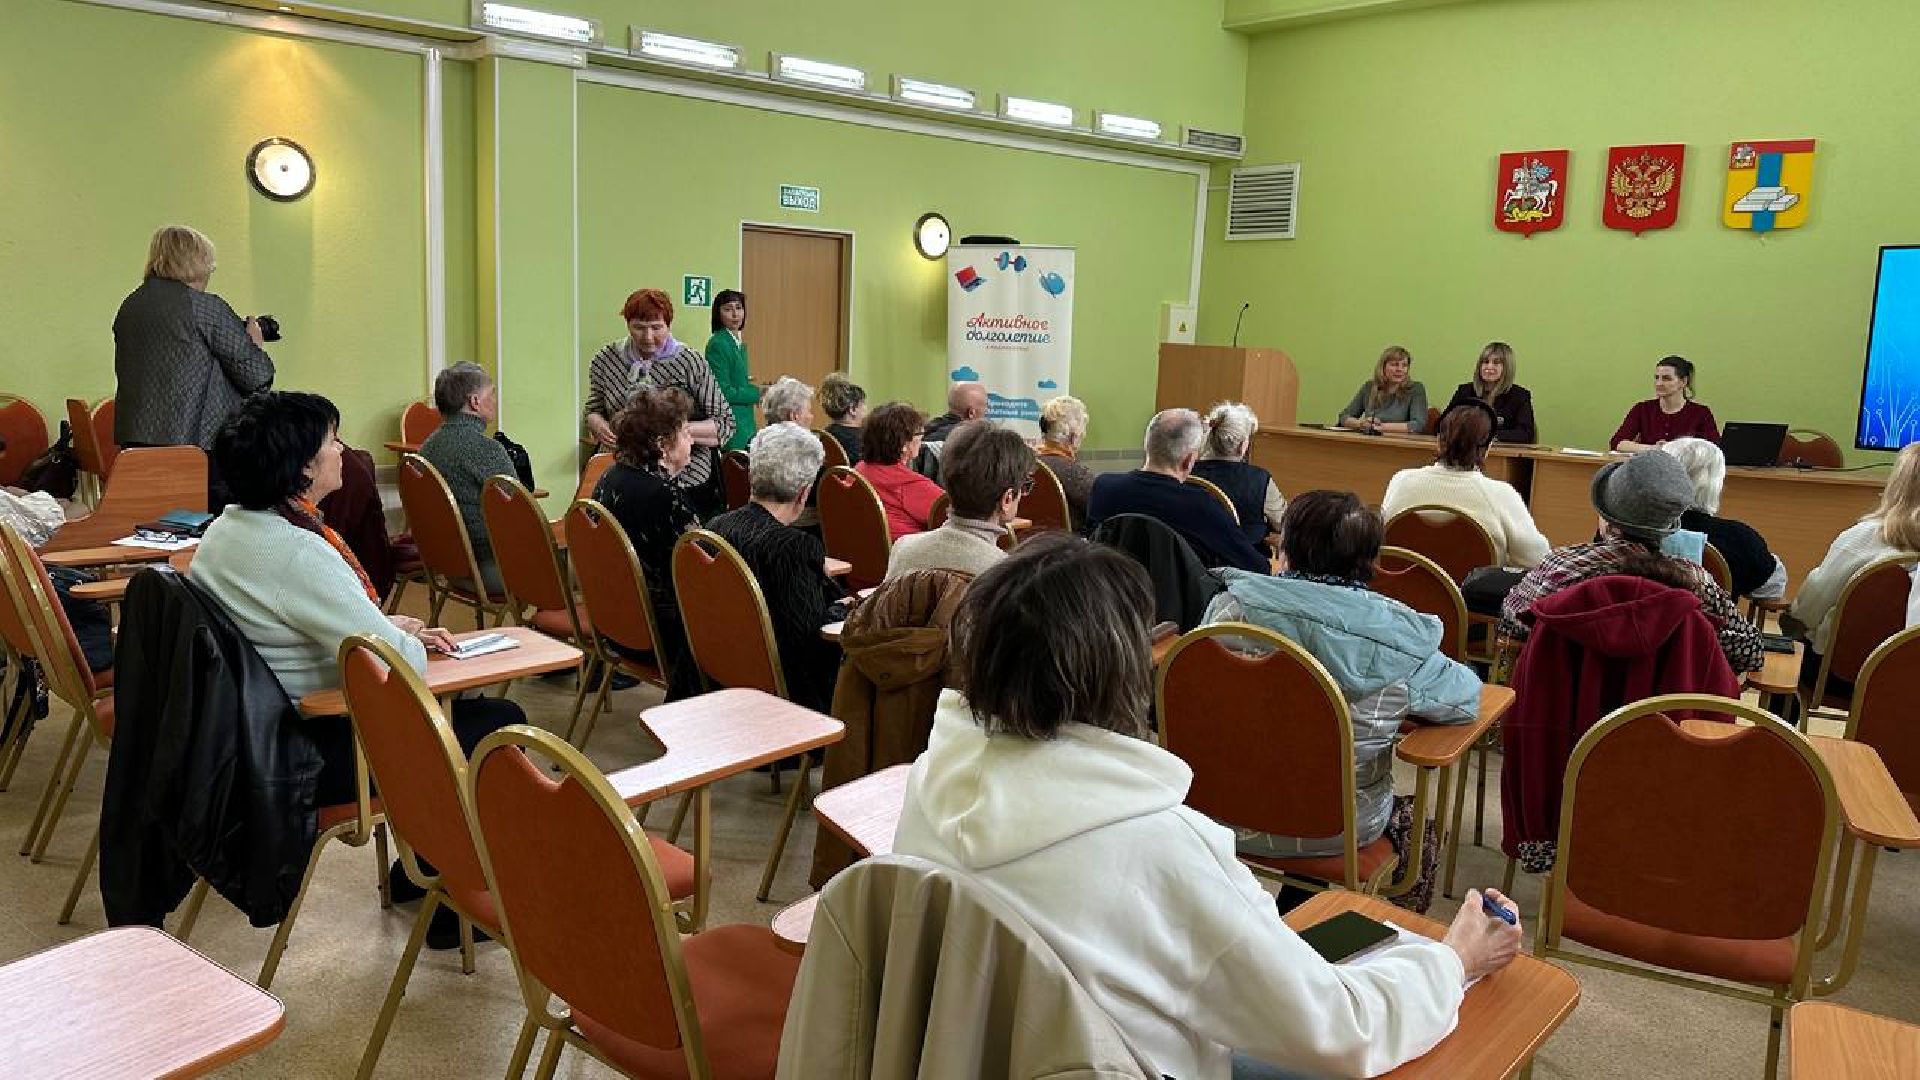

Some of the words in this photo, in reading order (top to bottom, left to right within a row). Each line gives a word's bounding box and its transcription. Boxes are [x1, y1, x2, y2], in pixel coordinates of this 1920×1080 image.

[783, 195, 816, 209] ВЫХОД
[966, 312, 1049, 330] Активное
[966, 327, 1051, 343] долголетие
